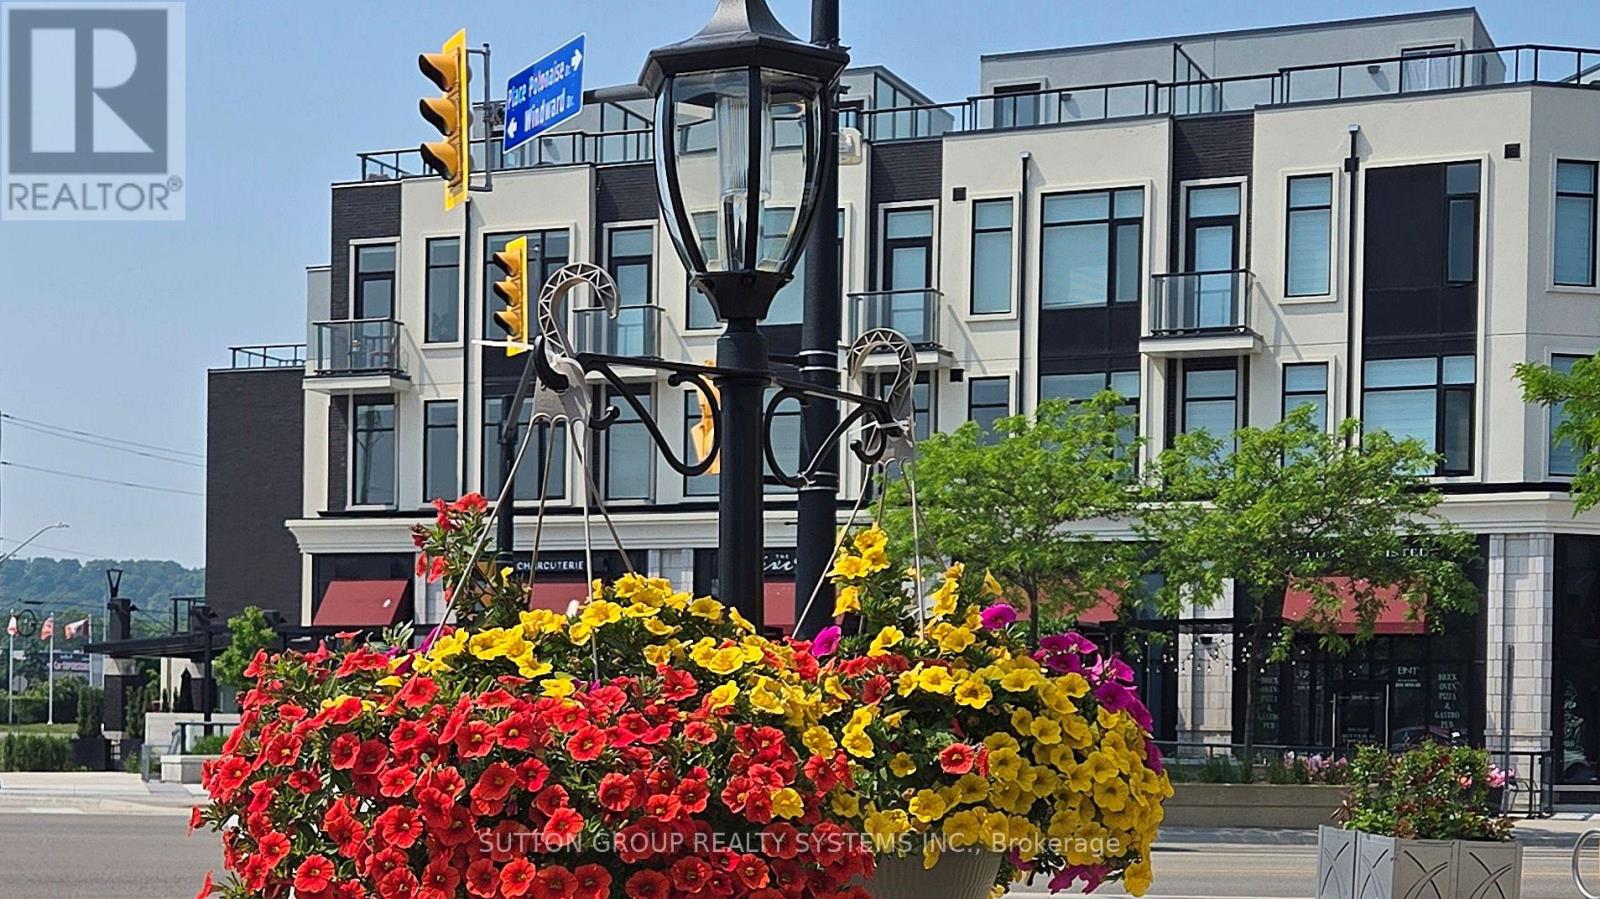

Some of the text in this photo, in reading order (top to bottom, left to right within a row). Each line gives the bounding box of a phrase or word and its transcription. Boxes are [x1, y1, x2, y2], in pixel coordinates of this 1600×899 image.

[507, 84, 527, 109] Place
[528, 60, 565, 98] Polonaise
[524, 87, 566, 132] Windward
[516, 560, 584, 571] CHRCUTERIE
